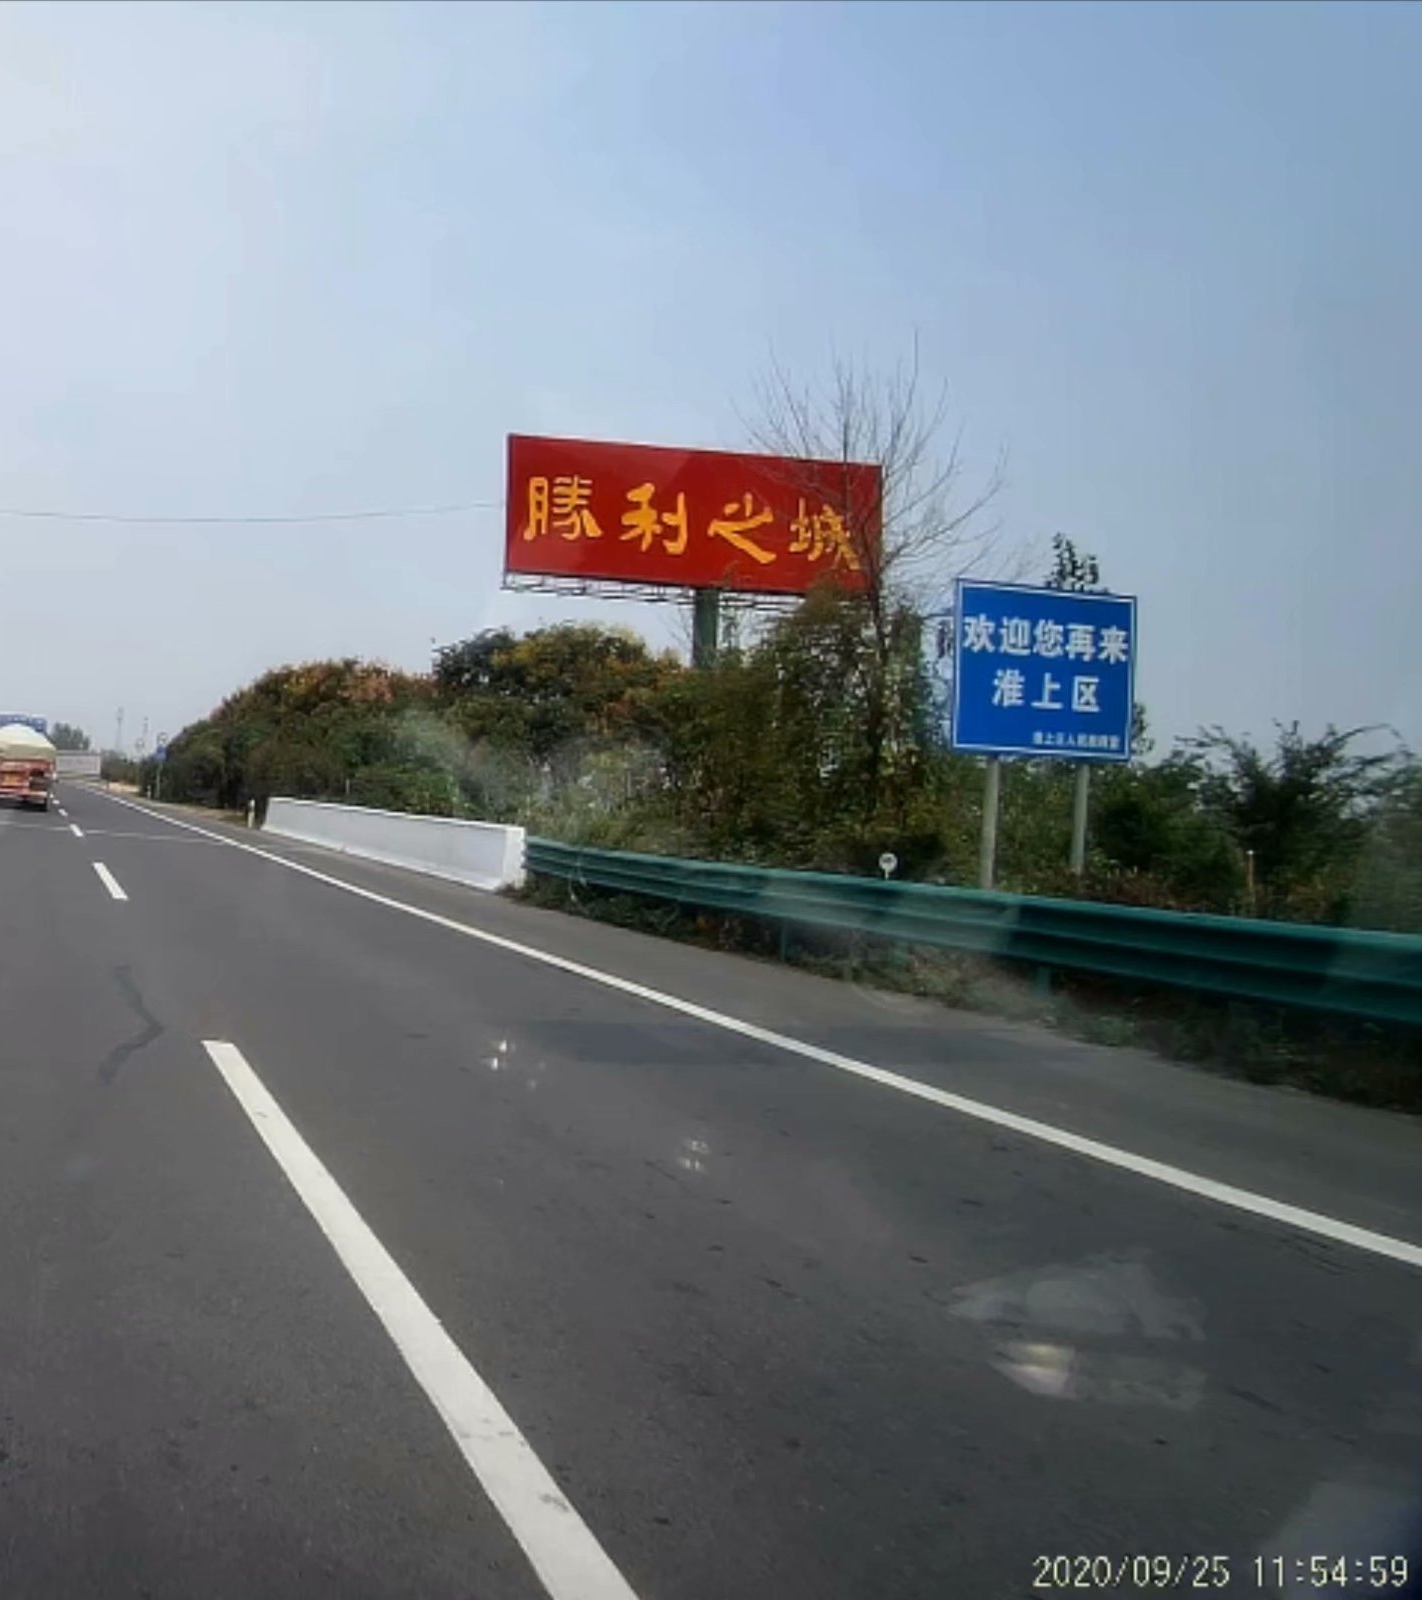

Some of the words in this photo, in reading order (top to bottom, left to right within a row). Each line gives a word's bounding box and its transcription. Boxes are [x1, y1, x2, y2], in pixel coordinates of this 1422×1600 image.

[963, 613, 1129, 664] 欢迎您再来
[991, 668, 1100, 712] 淮上区
